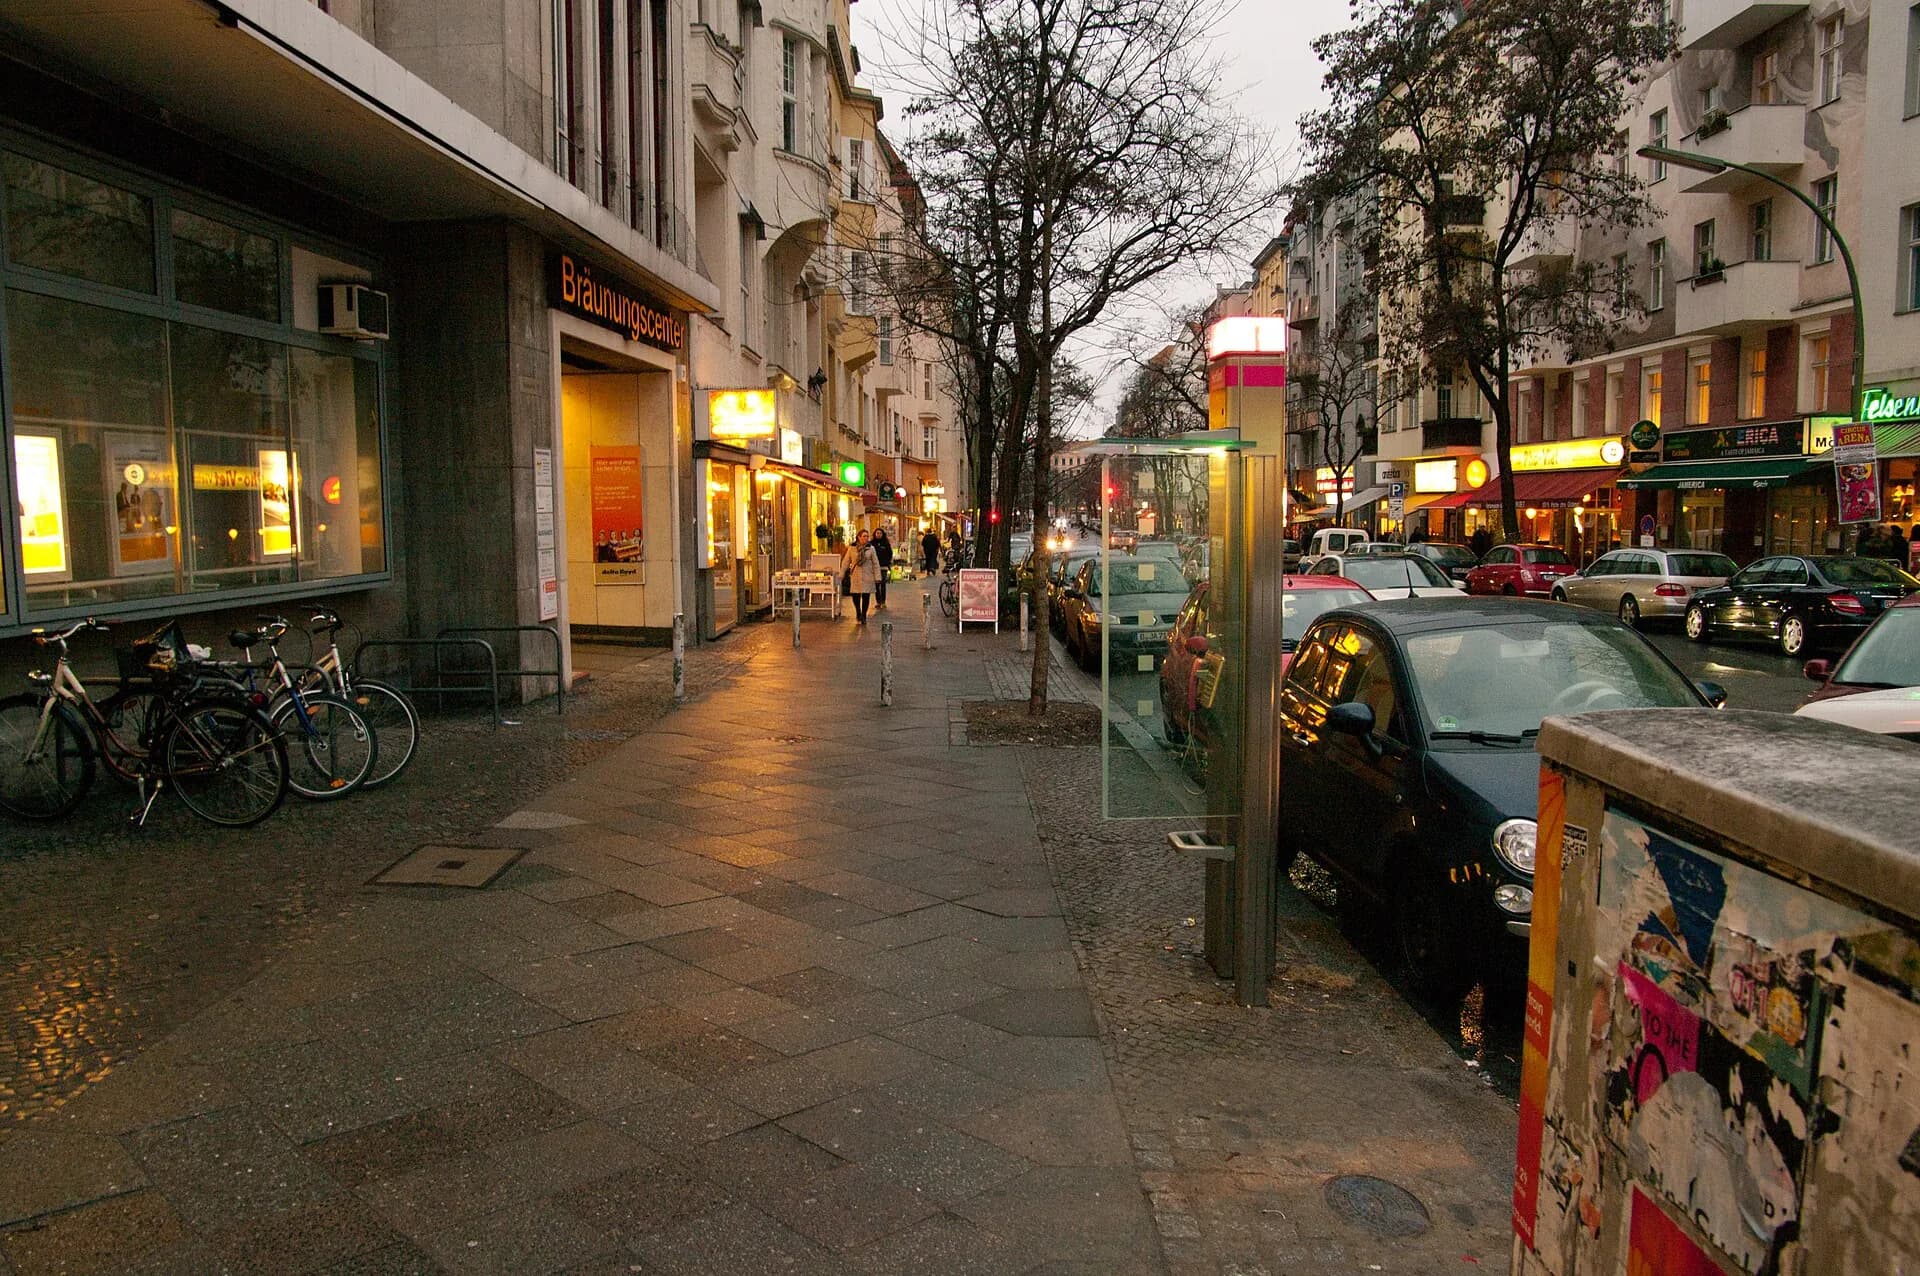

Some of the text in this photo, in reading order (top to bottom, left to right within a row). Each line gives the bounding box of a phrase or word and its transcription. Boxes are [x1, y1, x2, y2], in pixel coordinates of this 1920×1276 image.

[562, 255, 685, 349] Bräunungscenter
[1861, 388, 1920, 420] Felsen
[1841, 425, 1866, 434] CIRCUS
[1838, 433, 1871, 446] ARENA
[1392, 484, 1401, 497] P
[1677, 481, 1705, 489] JAMERICA
[1645, 1007, 1691, 1060] TO THE
